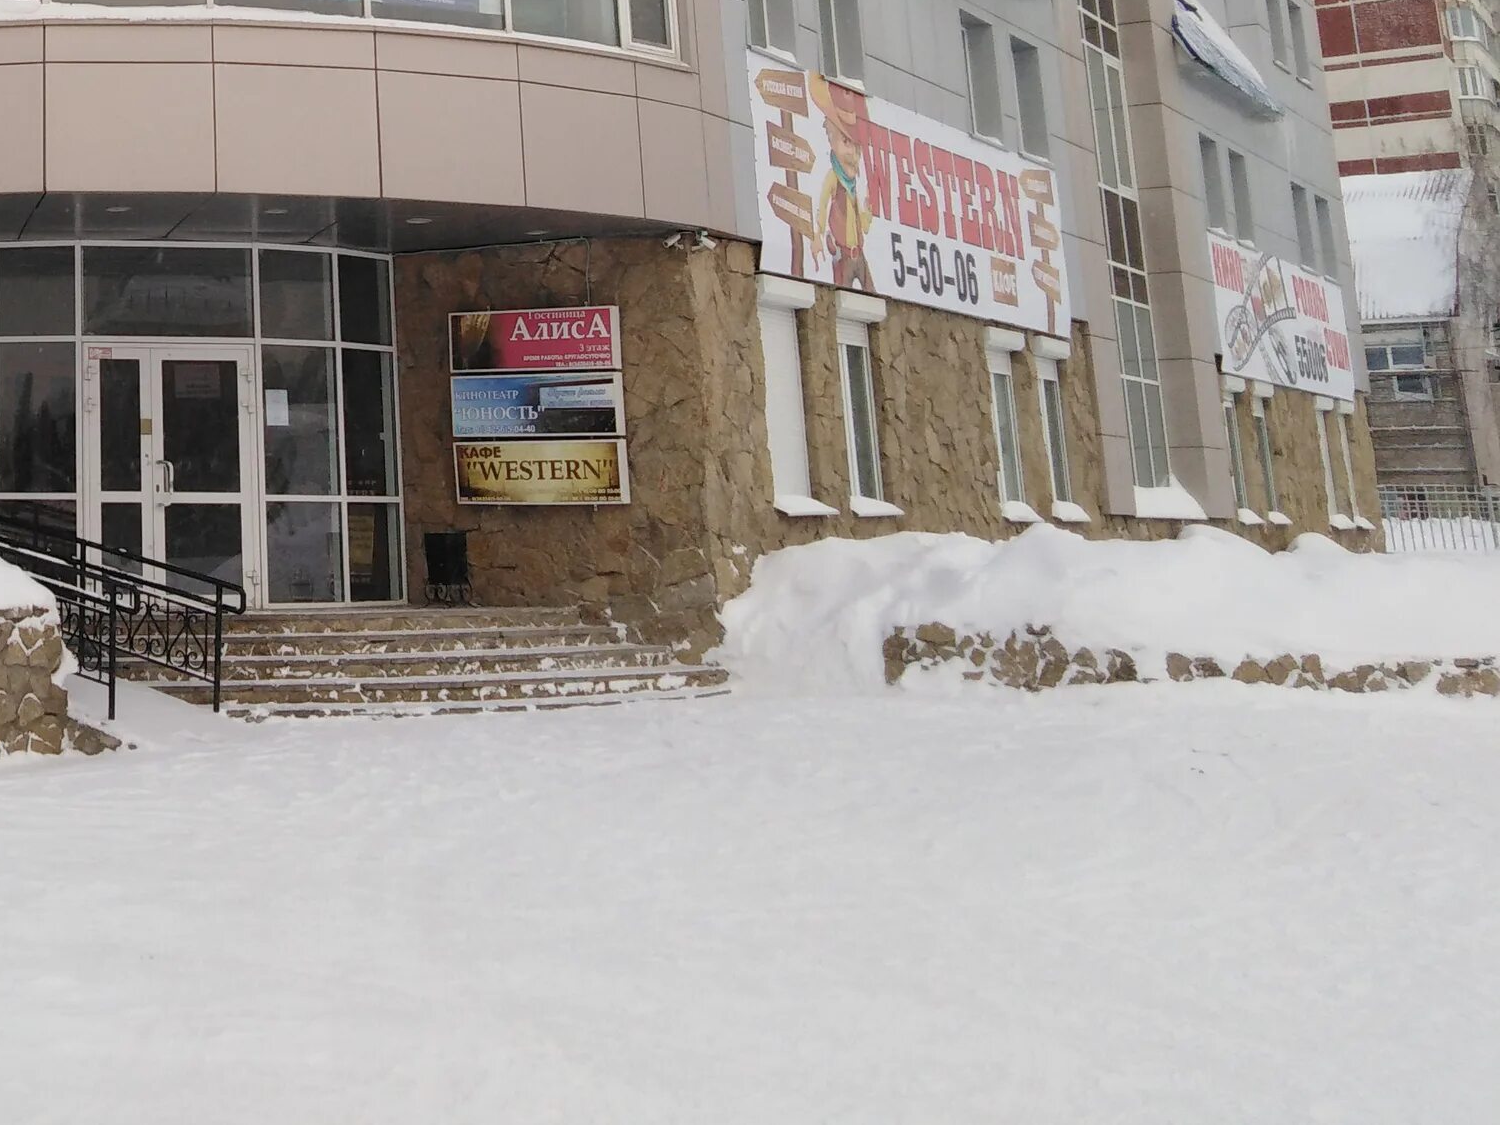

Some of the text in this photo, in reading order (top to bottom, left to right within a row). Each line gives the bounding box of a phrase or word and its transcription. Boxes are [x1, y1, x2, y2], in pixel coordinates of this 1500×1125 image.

[857, 122, 1025, 260] WESTERN
[890, 232, 979, 306] 5-50-06
[579, 343, 585, 352] 3
[454, 388, 519, 401] КИНОТЕАТР
[460, 446, 502, 459] КАФЕ
[467, 459, 613, 481] "WESTERN"
